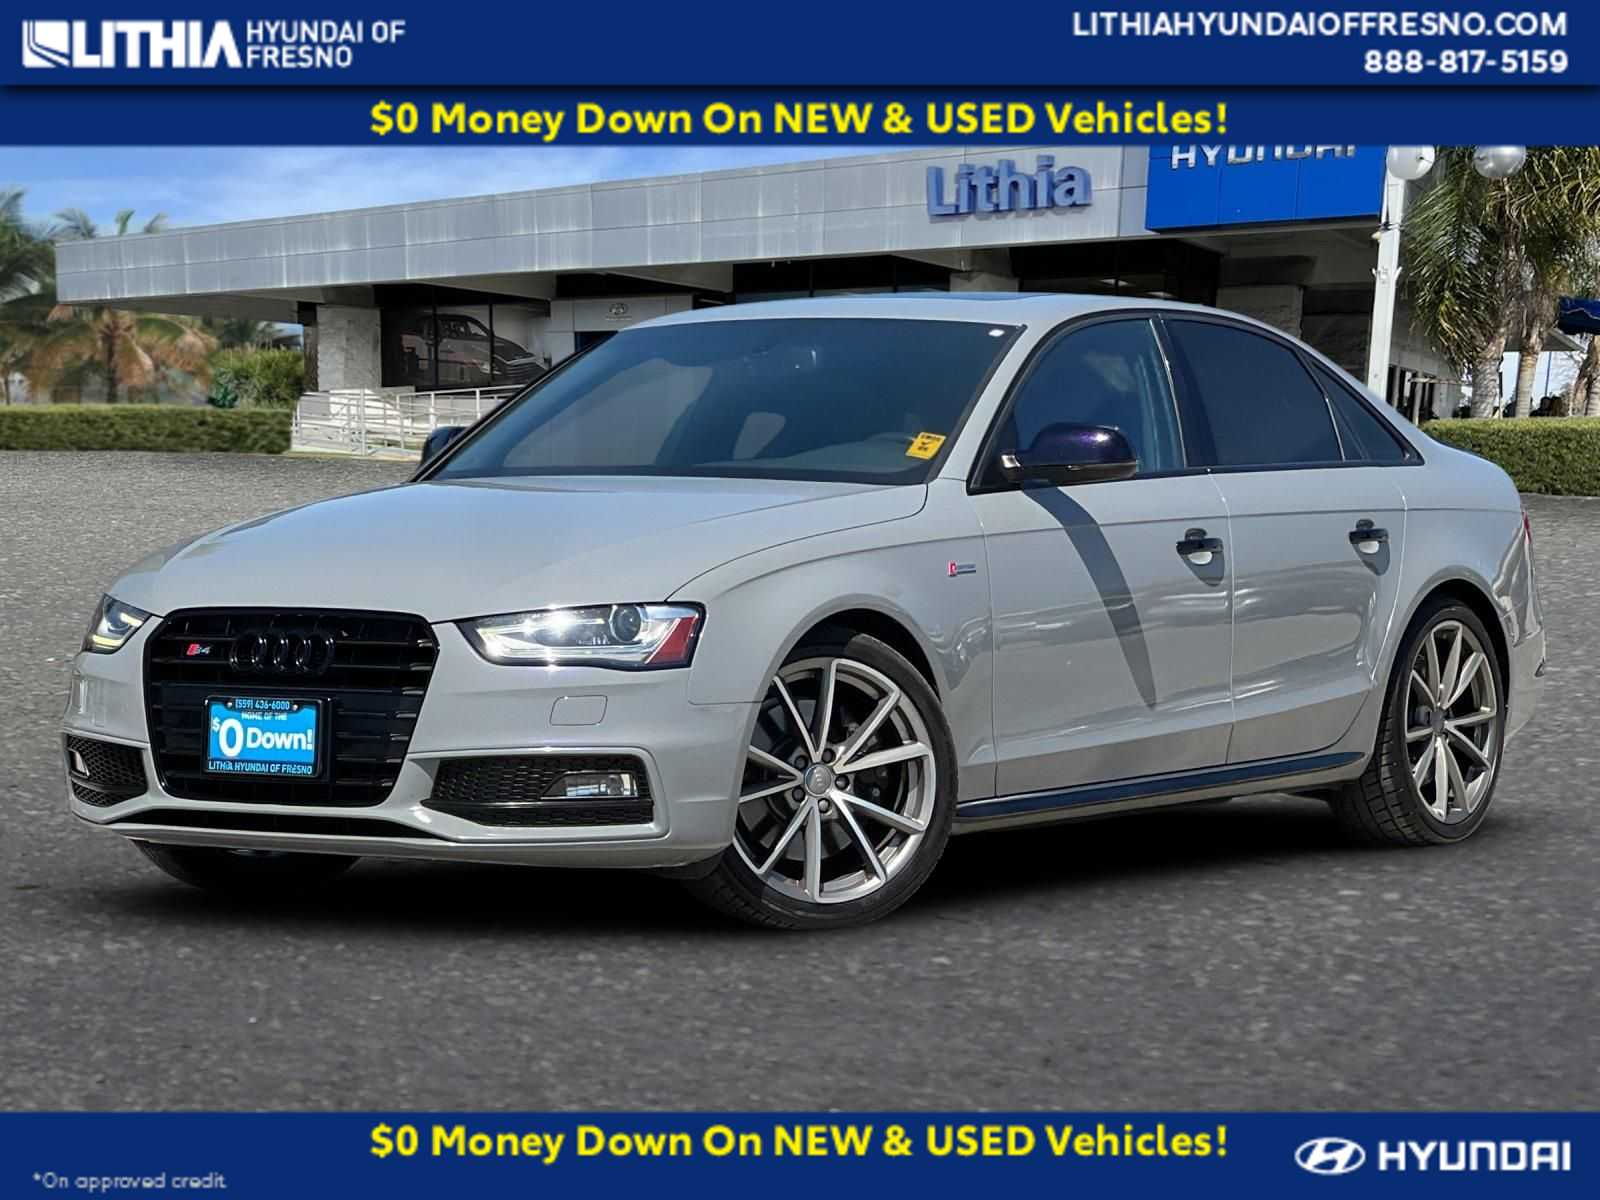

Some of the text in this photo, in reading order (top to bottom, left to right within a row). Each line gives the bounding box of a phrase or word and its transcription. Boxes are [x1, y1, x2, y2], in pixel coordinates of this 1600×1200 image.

[926, 155, 1092, 218] Lithia
[246, 727, 314, 751] Down!
[208, 761, 313, 774] LITHIA HYUNDAI OF FRESNO
